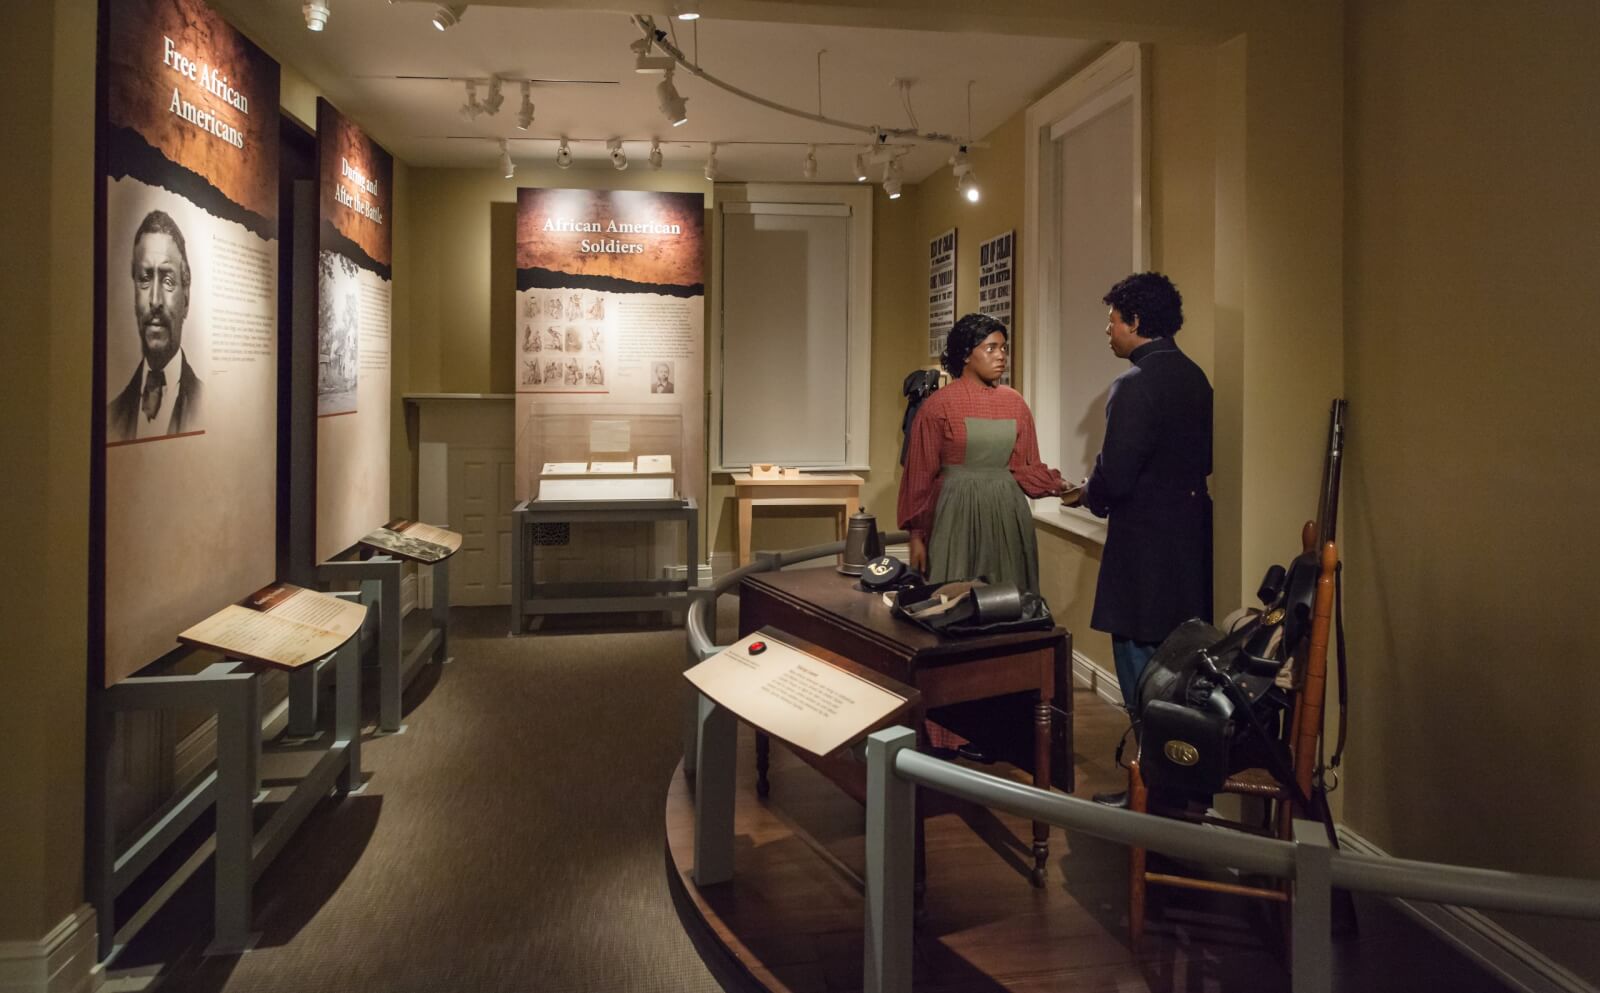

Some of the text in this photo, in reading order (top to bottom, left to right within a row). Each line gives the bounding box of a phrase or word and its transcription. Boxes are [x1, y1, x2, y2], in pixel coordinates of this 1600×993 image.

[163, 35, 249, 115] Free African
[169, 87, 244, 149] Americans
[342, 156, 378, 196] During and
[335, 183, 383, 224] After the Battle
[542, 218, 681, 235] African American
[581, 239, 645, 254] Soldiers
